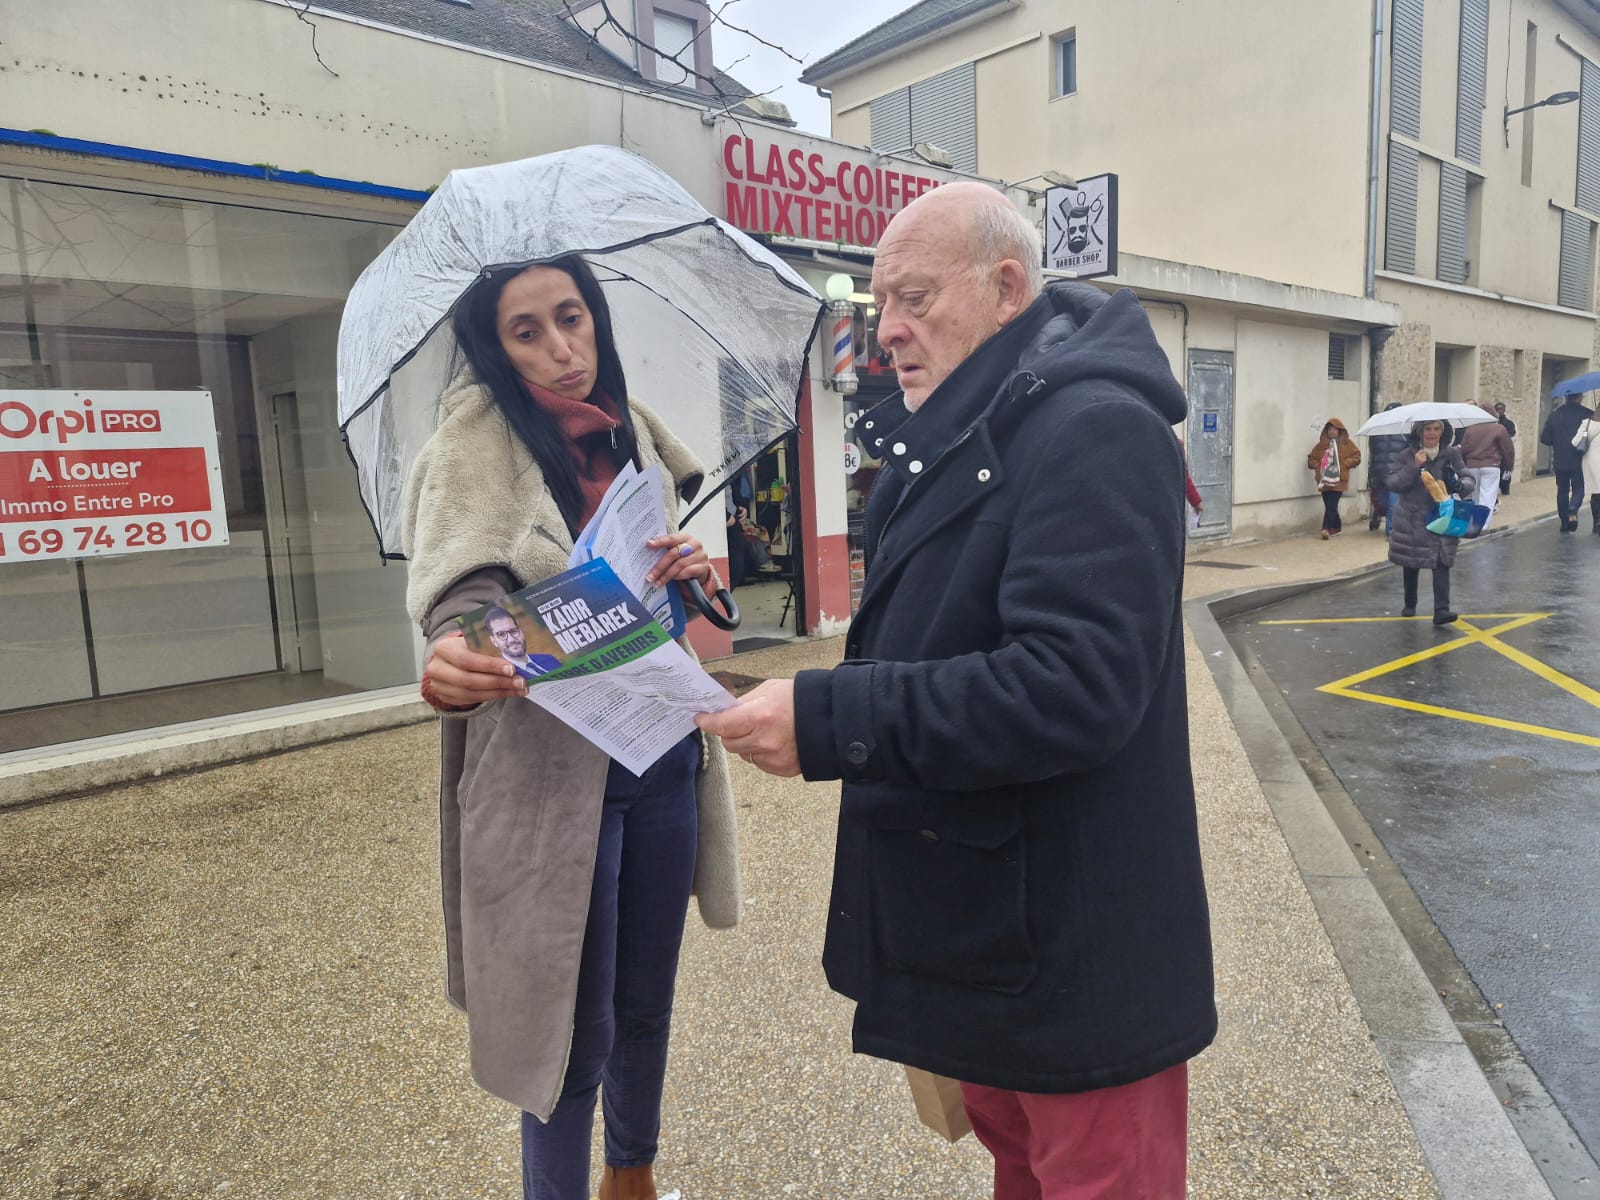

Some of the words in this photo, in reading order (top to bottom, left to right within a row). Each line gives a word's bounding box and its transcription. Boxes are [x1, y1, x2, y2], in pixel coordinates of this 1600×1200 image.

[724, 134, 947, 209] CLASS-COIFFE
[1056, 257, 1080, 268] BARBER
[1082, 253, 1099, 263] SHOP
[0, 399, 96, 443] Orpi
[104, 413, 157, 429] PRO
[28, 458, 52, 482] A
[58, 457, 142, 481] louer
[1, 499, 67, 515] Immo
[74, 495, 133, 511] Entre
[138, 492, 174, 508] Pro
[18, 528, 64, 555] 69
[72, 525, 115, 551] 74
[124, 522, 167, 547] 28
[175, 519, 212, 543] 10
[541, 598, 592, 634] KADIR
[554, 602, 638, 654] MEBAREK
[589, 630, 659, 670] D'AVENIRS
